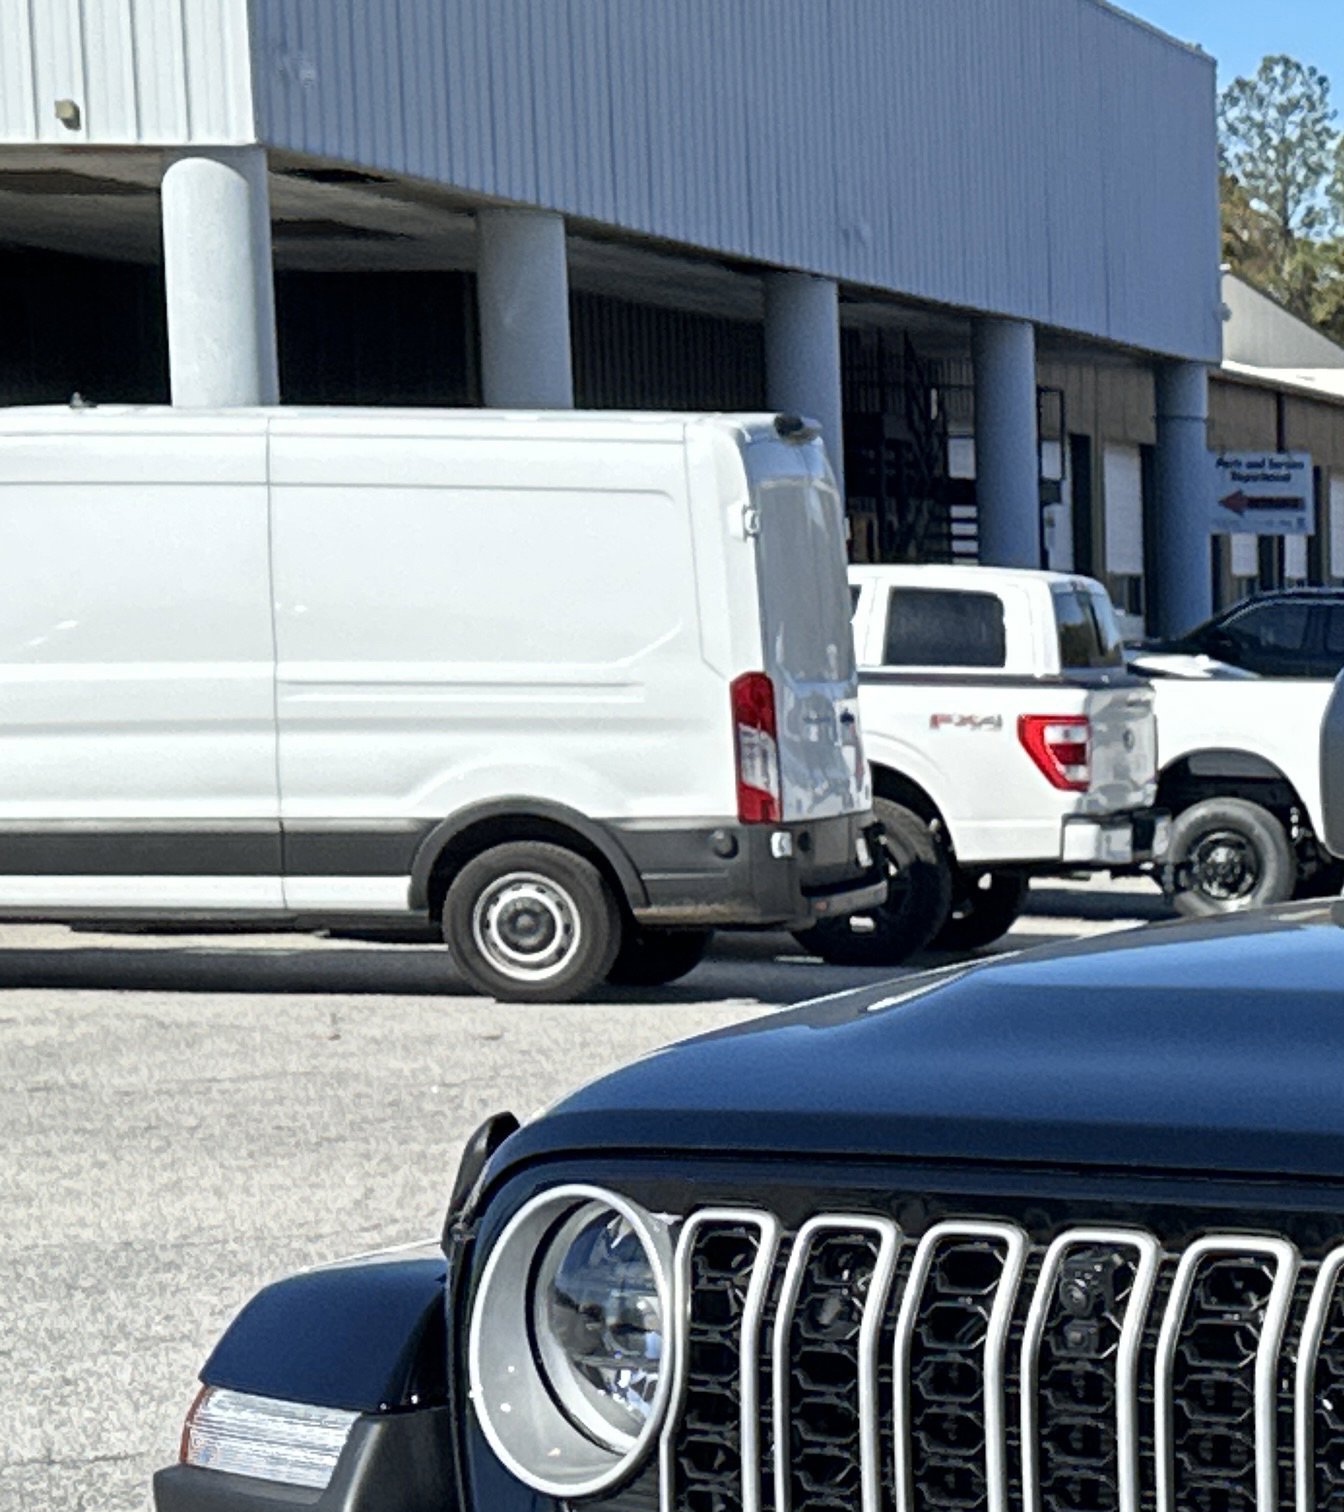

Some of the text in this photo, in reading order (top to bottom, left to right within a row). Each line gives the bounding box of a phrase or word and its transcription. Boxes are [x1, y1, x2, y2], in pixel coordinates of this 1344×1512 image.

[1216, 457, 1243, 469] Parts
[1246, 457, 1266, 469] and
[1231, 471, 1291, 483] Department
[929, 713, 1003, 730] FX4
